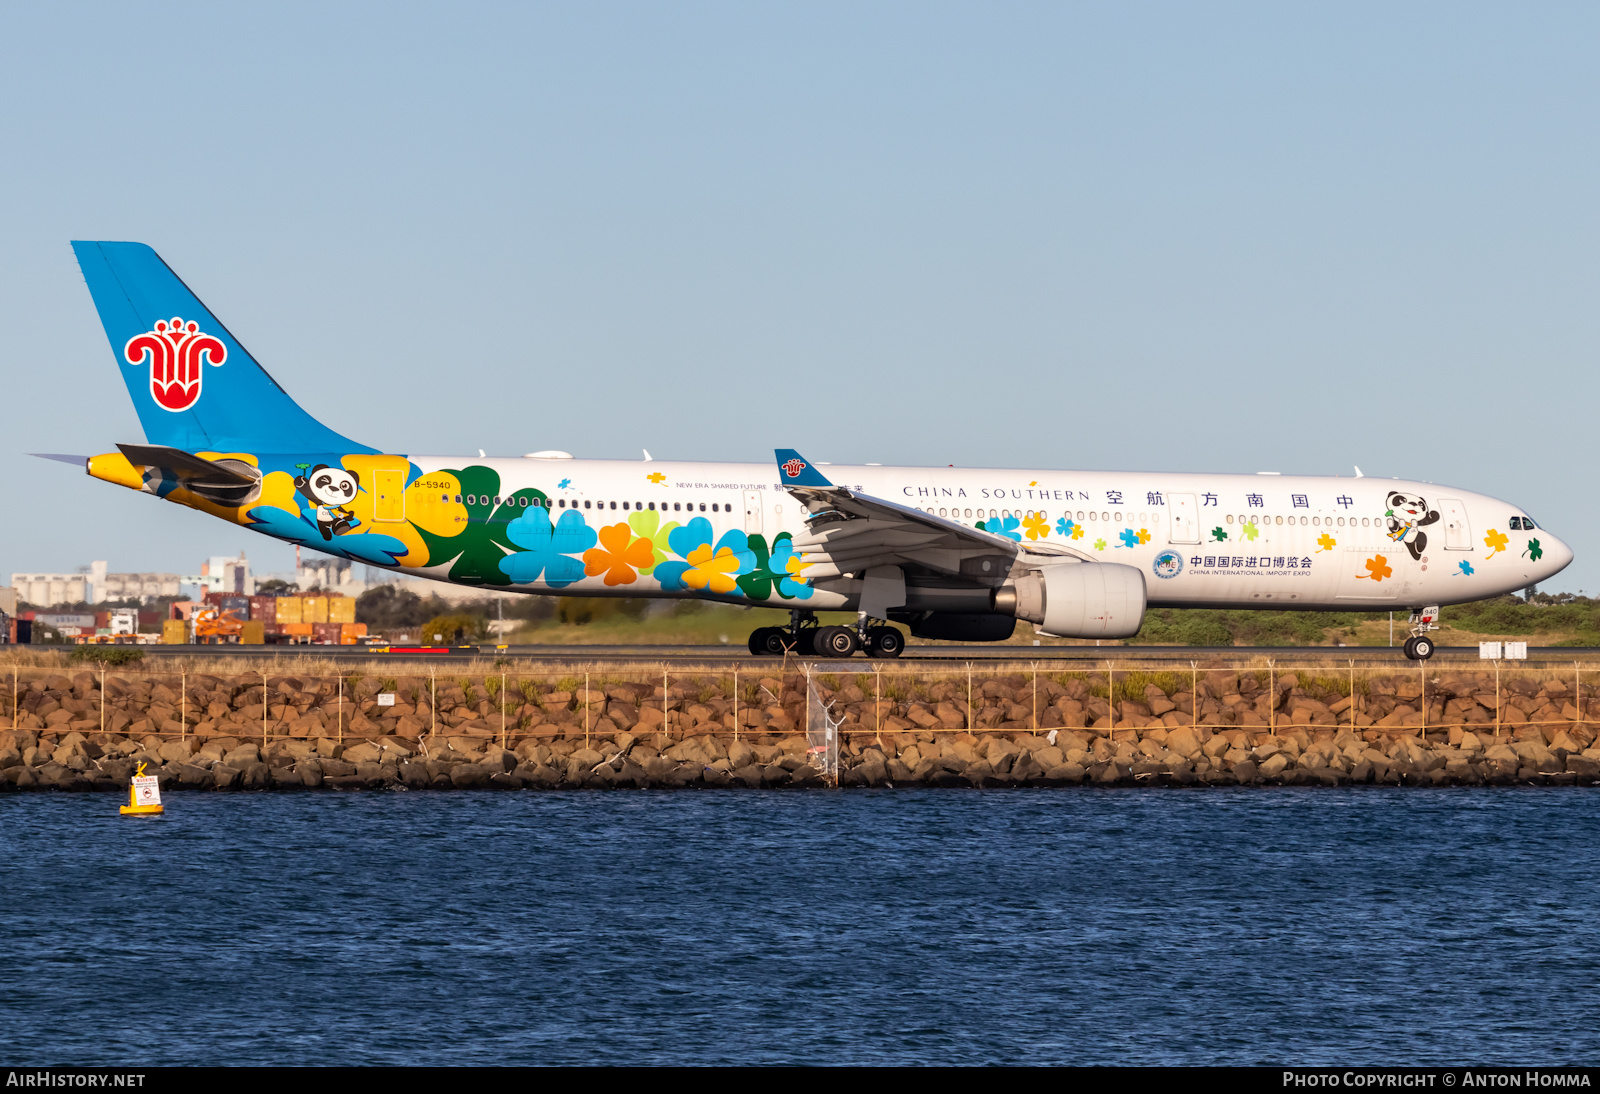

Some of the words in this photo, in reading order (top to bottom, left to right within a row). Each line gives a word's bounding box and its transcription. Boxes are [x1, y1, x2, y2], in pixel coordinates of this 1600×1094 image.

[414, 480, 451, 489] B-5940
[903, 485, 968, 499] CHINA
[981, 487, 1090, 502] SOUTHERN
[1190, 555, 1313, 569] 中国国际进口博览会
